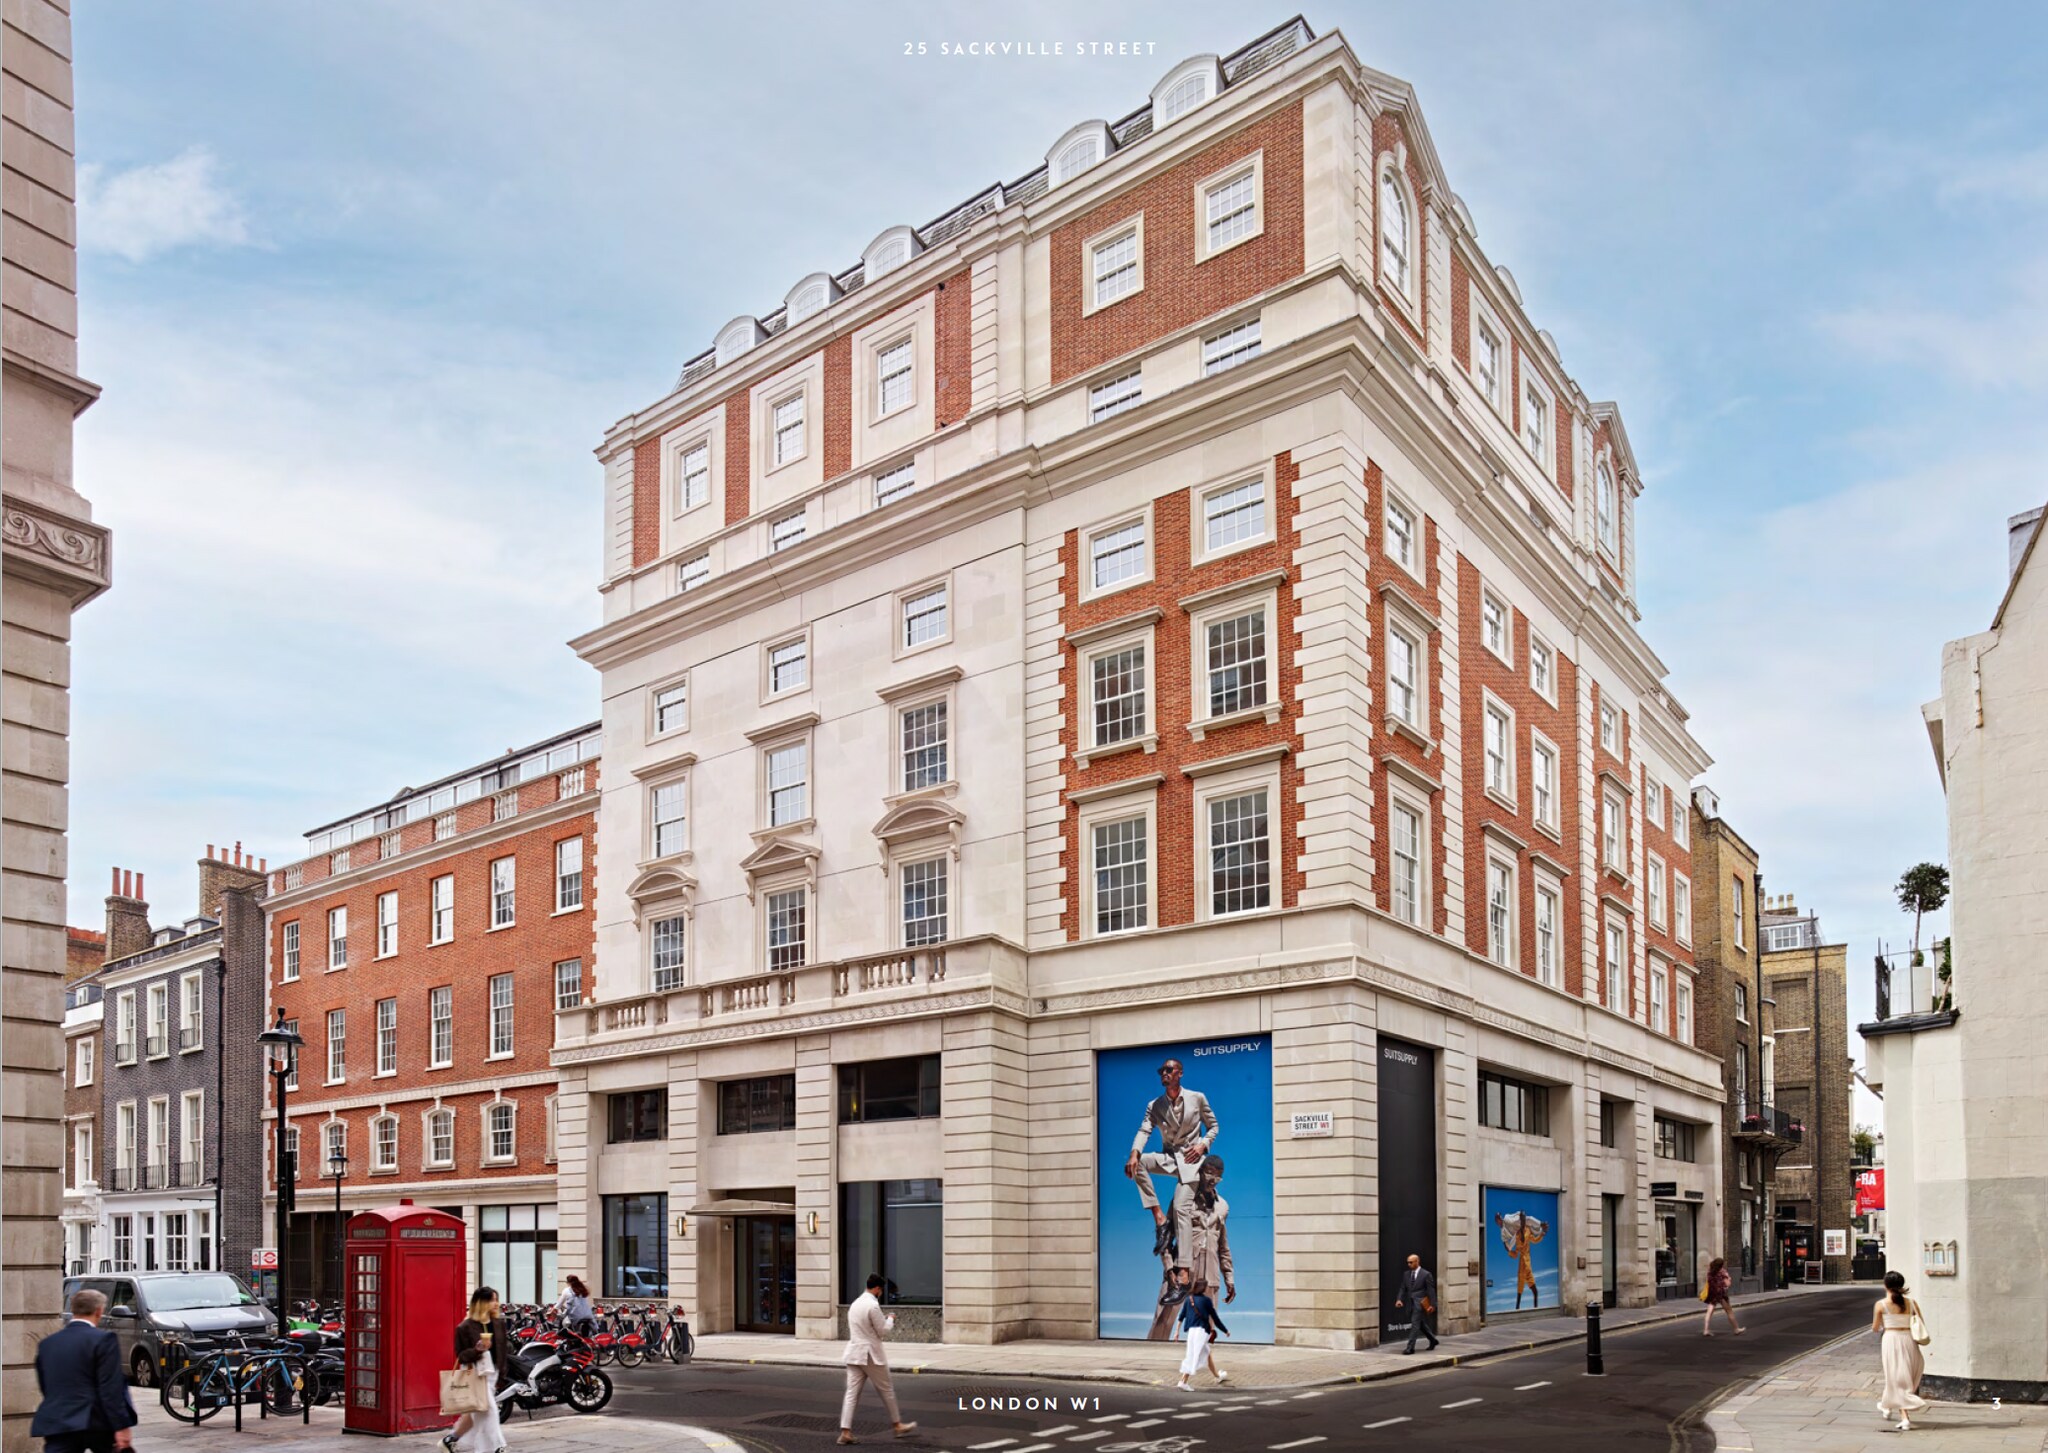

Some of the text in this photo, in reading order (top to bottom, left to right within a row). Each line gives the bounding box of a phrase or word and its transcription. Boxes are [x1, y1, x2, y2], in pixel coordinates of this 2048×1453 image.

[1193, 1042, 1261, 1056] SUITSUPPLY
[1383, 1047, 1418, 1066] SUITSUPPLY
[1294, 1114, 1329, 1122] SACKVILLE
[1294, 1121, 1330, 1130] STREET W1
[1861, 1172, 1877, 1185] RA
